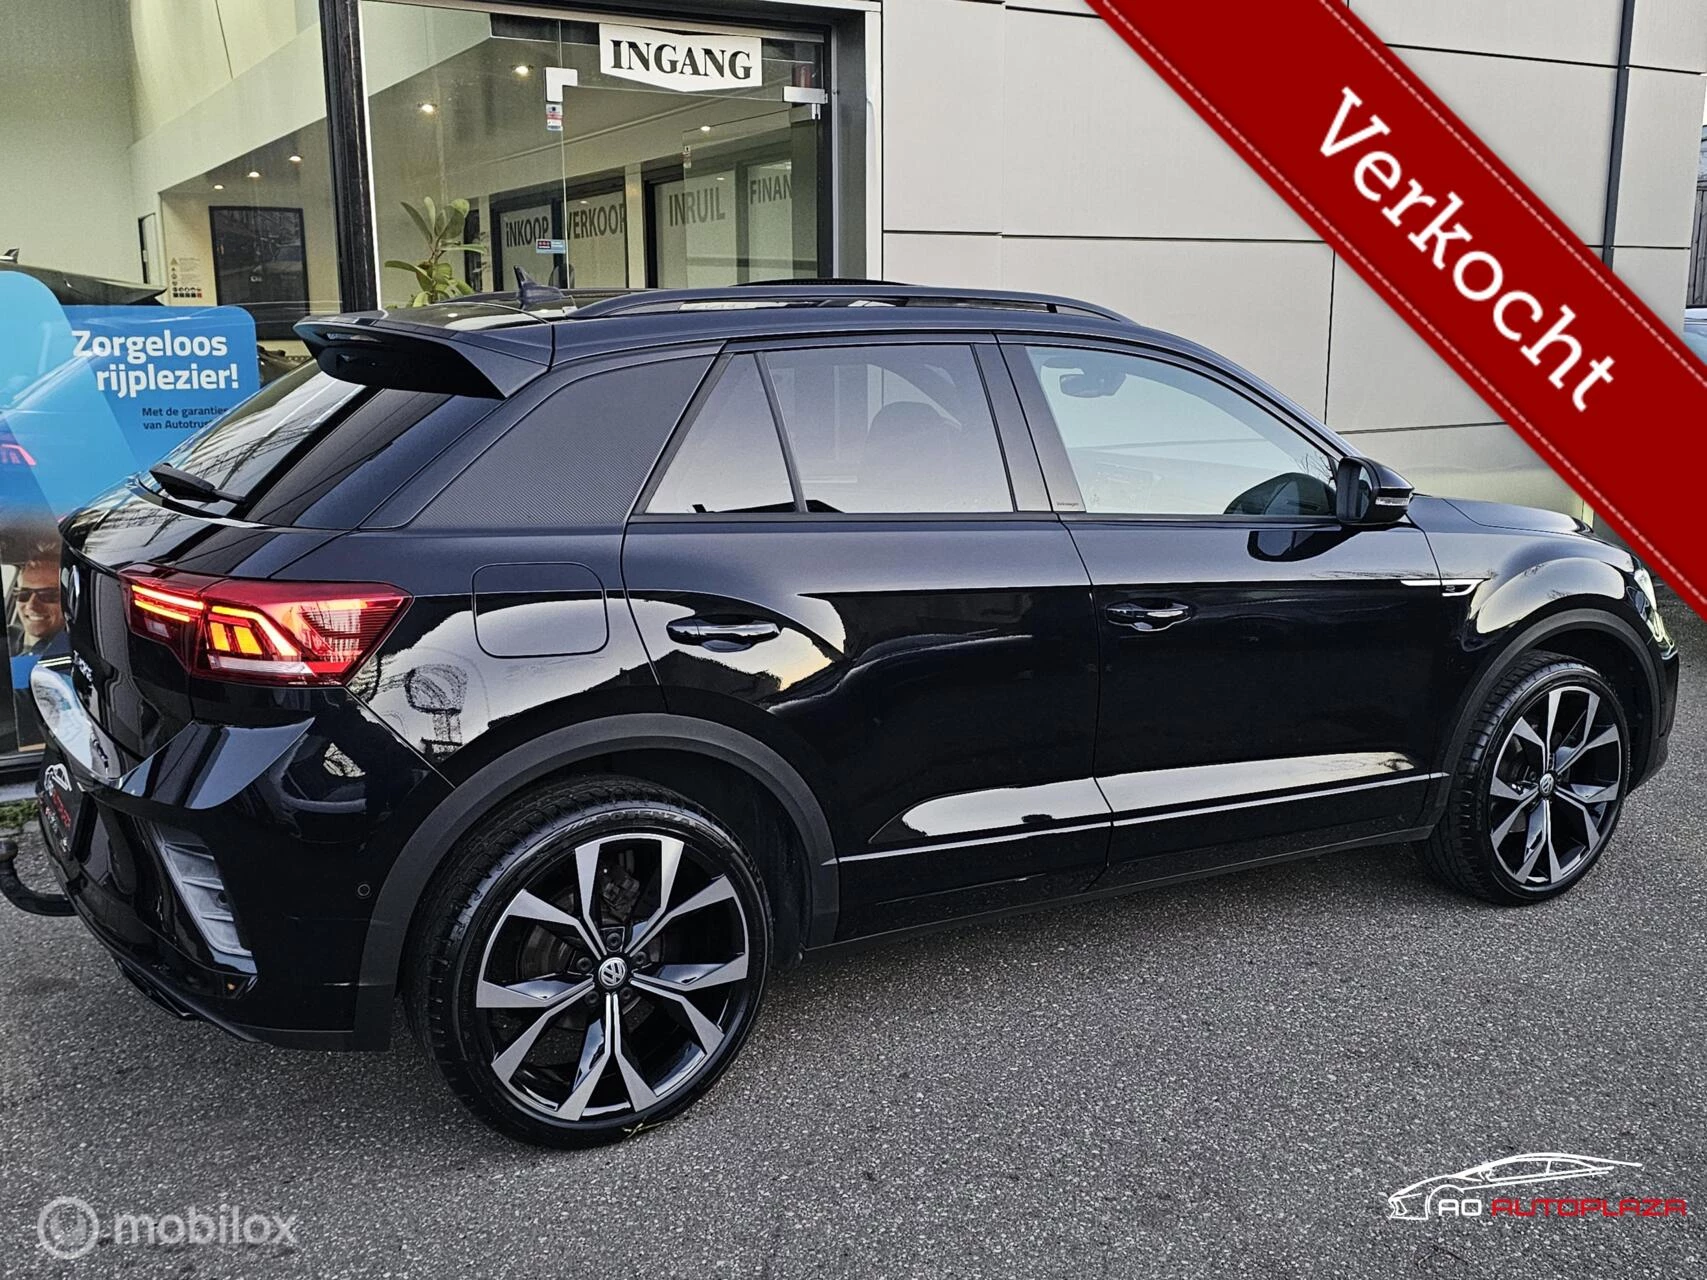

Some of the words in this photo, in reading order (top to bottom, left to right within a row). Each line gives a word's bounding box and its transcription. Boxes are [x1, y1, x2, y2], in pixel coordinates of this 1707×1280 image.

[610, 39, 753, 80] INGANG
[669, 187, 726, 227] INRUIL
[71, 329, 228, 364] Zorgeloos
[96, 363, 240, 398] rijplezier!
[142, 408, 163, 417] Met
[166, 407, 179, 417] de
[143, 422, 162, 430] van
